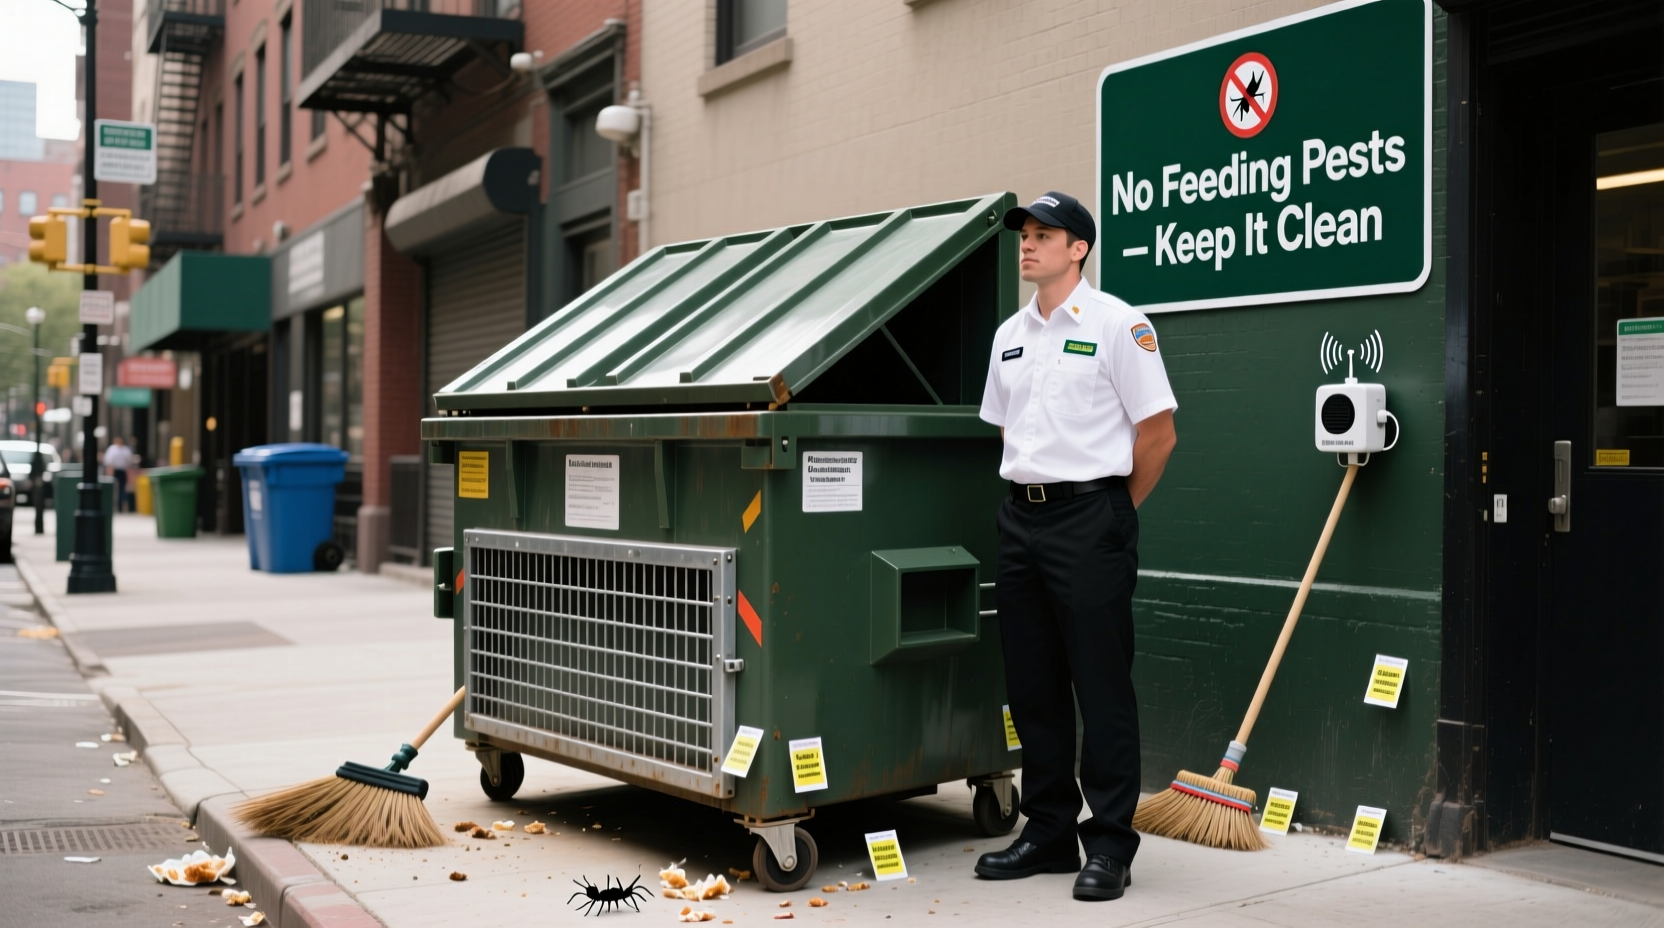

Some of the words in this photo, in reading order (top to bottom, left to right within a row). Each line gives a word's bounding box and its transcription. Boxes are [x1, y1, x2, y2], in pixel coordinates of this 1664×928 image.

[1112, 172, 1154, 215] No
[1162, 151, 1291, 207] Feeding
[1302, 130, 1406, 185] Pests
[1245, 212, 1268, 256] It
[1277, 202, 1383, 252] Clean
